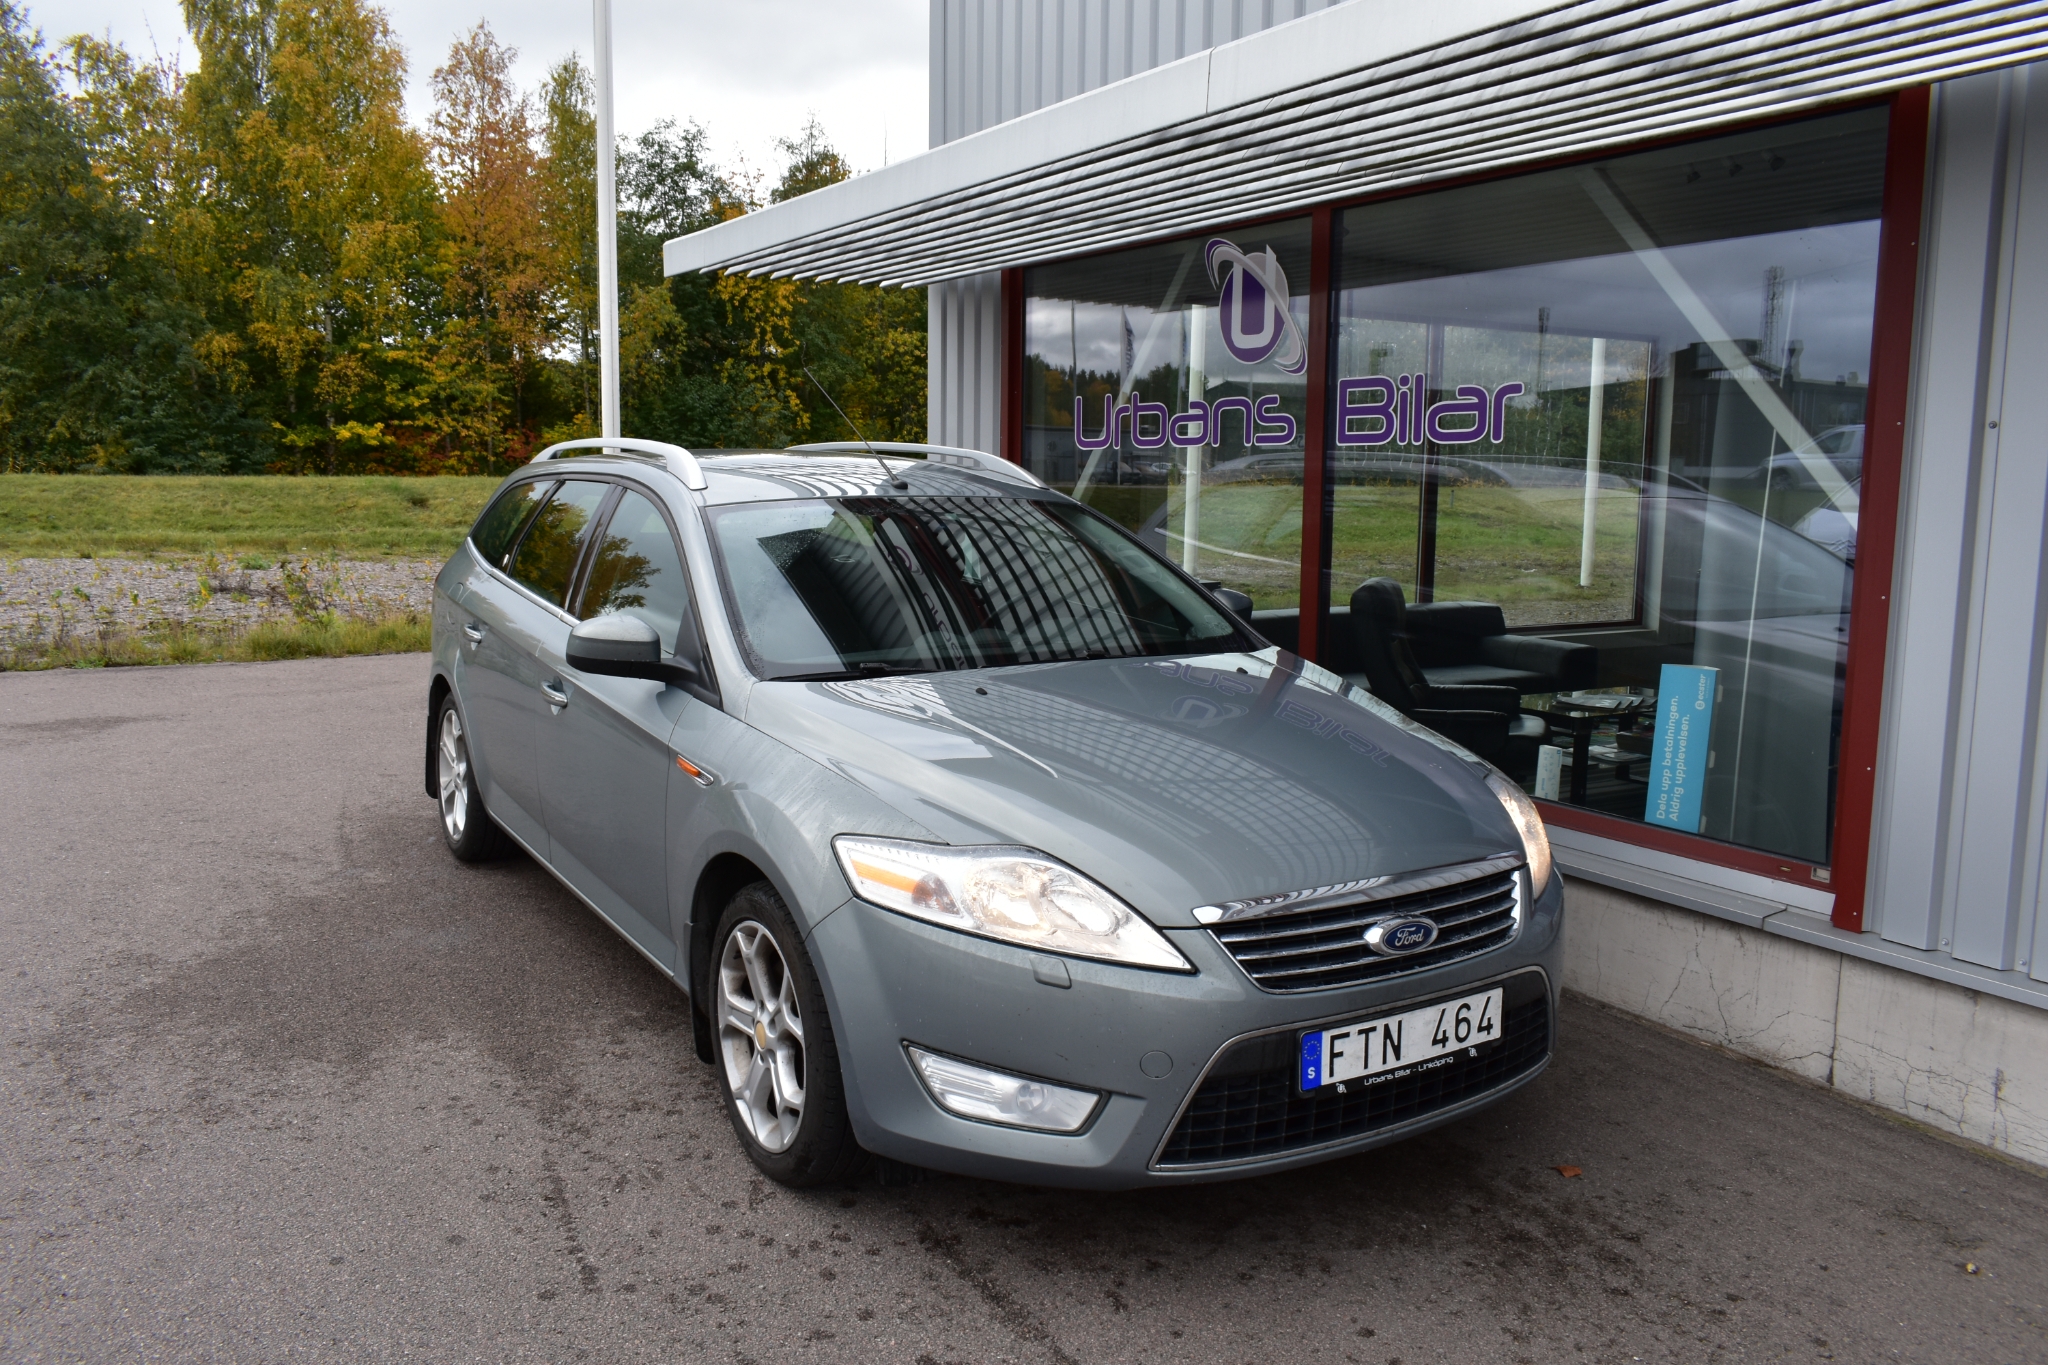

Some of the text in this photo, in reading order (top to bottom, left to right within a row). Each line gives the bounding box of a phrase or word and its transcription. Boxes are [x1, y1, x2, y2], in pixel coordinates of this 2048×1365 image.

[1074, 372, 1526, 450] Urbans Bilar
[1656, 695, 1679, 819] Dela upp betalningen.
[1669, 714, 1690, 822] Aldrig upplevelsen.
[1394, 926, 1424, 947] Ford
[1307, 1066, 1316, 1079] S
[1329, 995, 1494, 1078] FTN 464
[1364, 1073, 1394, 1086] Urbans
[1395, 1068, 1412, 1078] Bilar
[1417, 1056, 1454, 1072] Linköping
